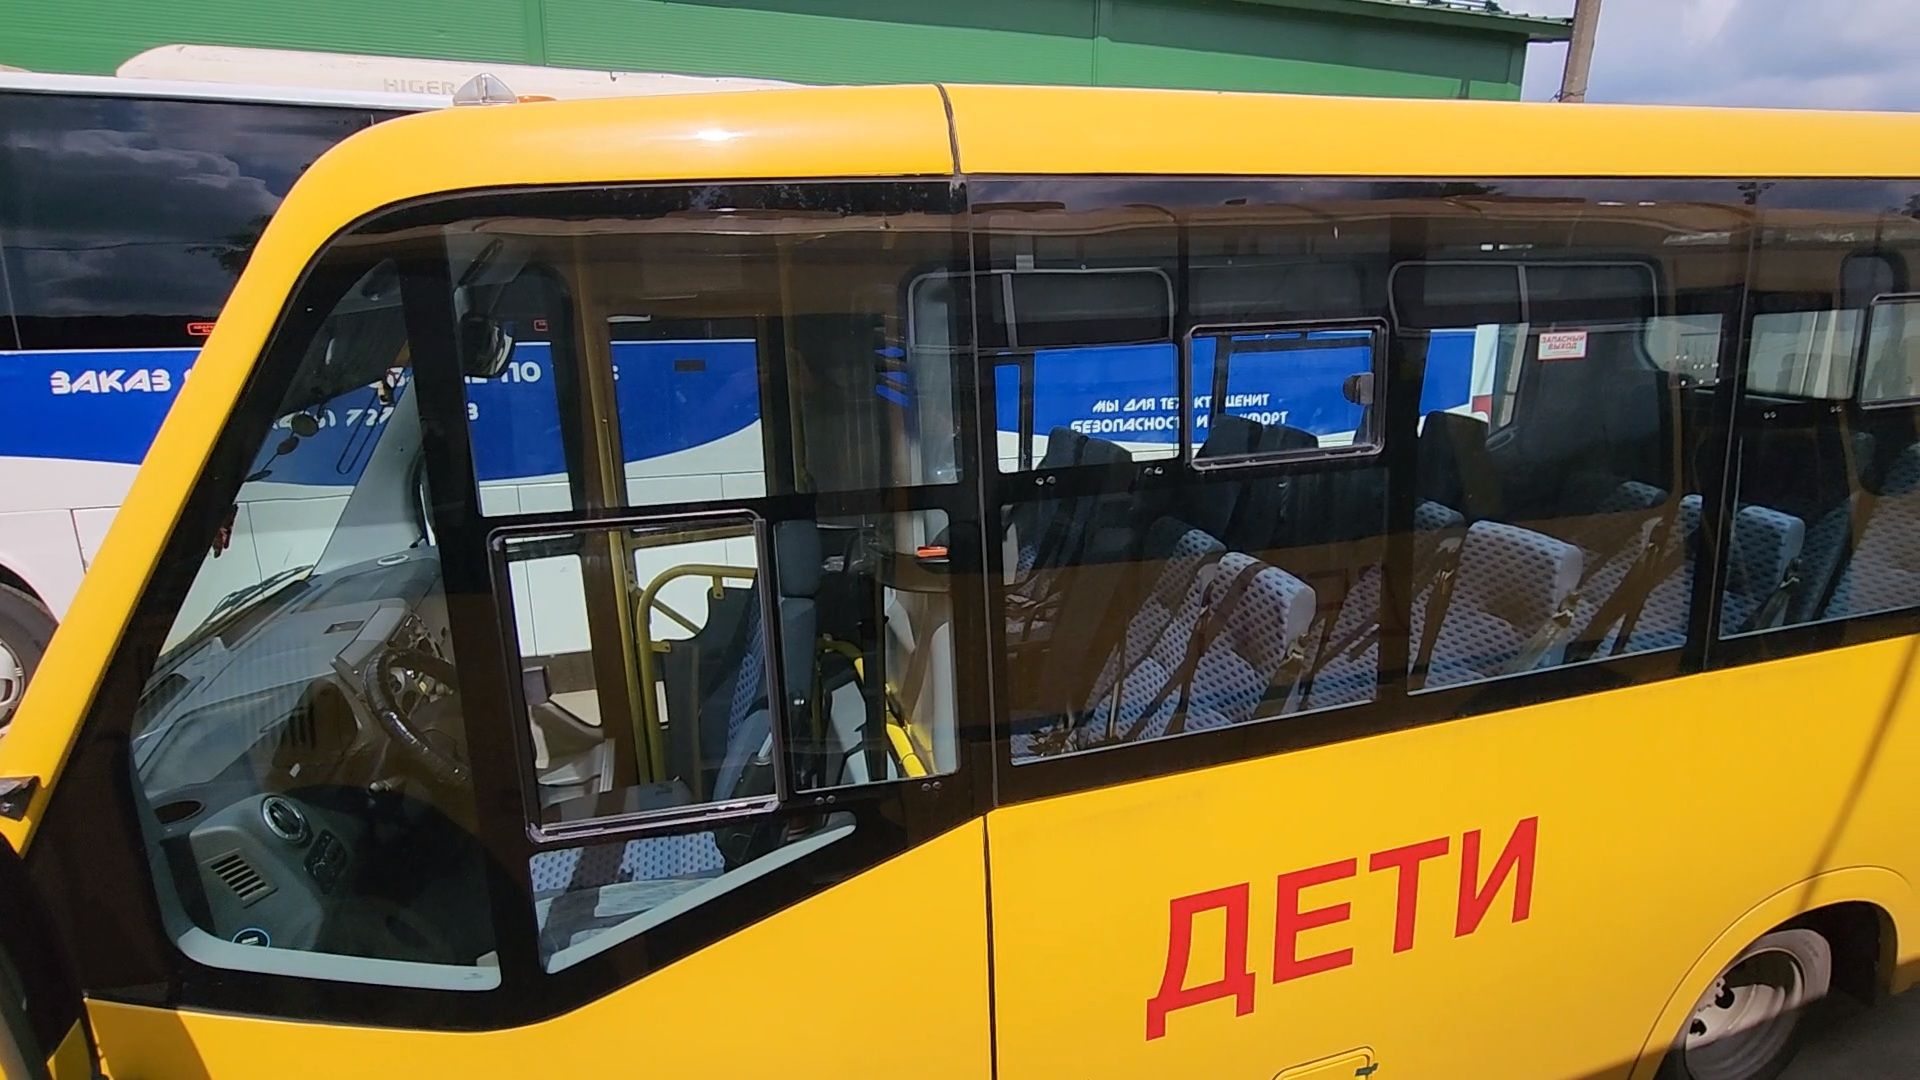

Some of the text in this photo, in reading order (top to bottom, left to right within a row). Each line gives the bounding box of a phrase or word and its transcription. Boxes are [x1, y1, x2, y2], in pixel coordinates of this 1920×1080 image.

[383, 77, 456, 96] HIGER
[1547, 342, 1577, 350] ВЫХОД
[50, 368, 171, 395] ЗАКАЗ
[1092, 399, 1119, 413] МЫ
[1123, 397, 1156, 412] ДЛЯ
[1194, 395, 1213, 409] КТ
[1225, 393, 1270, 408] ЦЕНИТ
[1070, 416, 1180, 434] БЕЗОПАСНОСТ
[1196, 414, 1209, 428] И
[1146, 816, 1539, 1041] ДЕТИ
